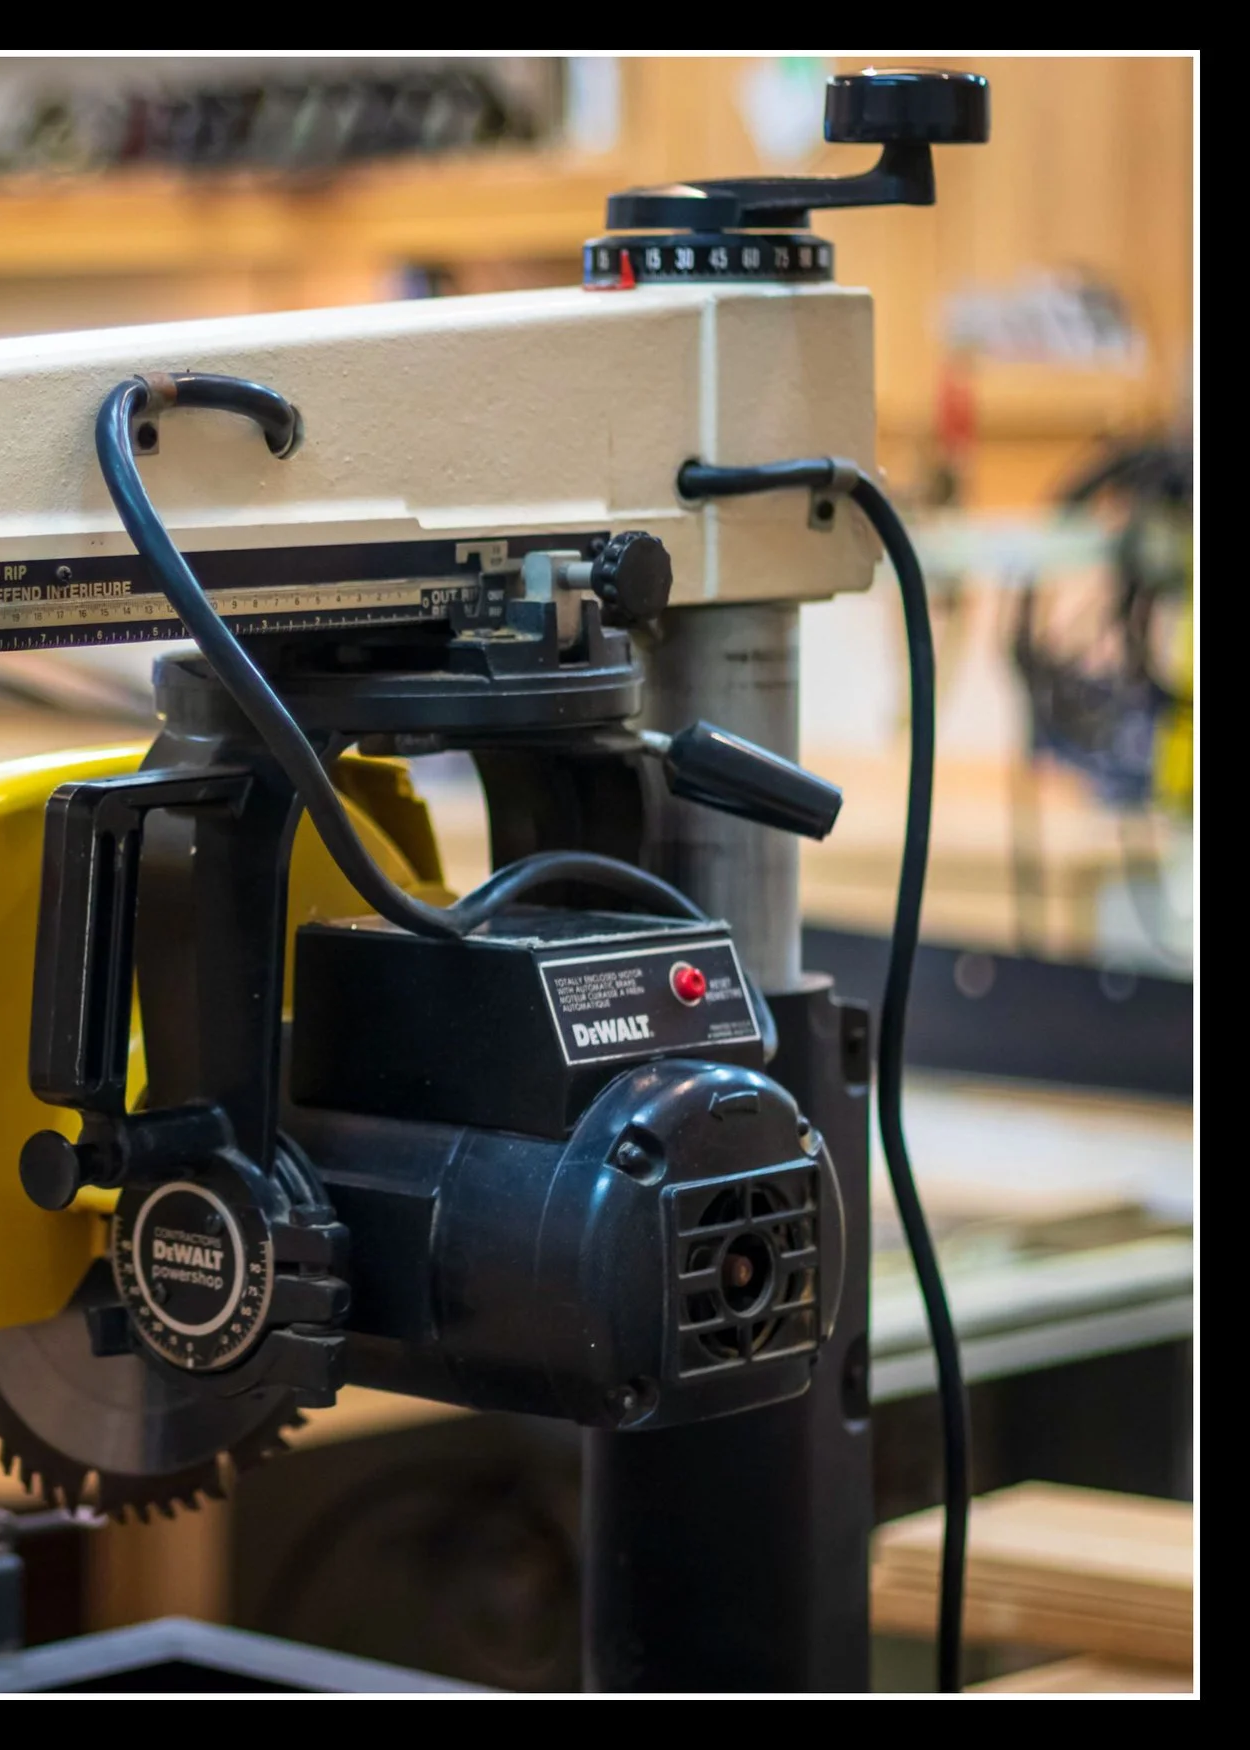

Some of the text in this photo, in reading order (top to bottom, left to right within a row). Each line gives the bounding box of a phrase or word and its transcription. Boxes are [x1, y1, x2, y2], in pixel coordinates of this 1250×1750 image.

[645, 247, 662, 270] 15
[674, 247, 695, 270] 30
[709, 246, 728, 270] 45
[741, 246, 760, 269] 60
[4, 565, 27, 581] RIP
[46, 581, 132, 600] INTERIEURE
[431, 589, 458, 604] OUT
[12, 614, 20, 623] 19
[56, 610, 64, 619] 17
[78, 609, 87, 618] 16
[100, 608, 109, 617] 15
[123, 607, 131, 616] 14
[145, 605, 154, 614] 13
[231, 600, 238, 609] 9
[40, 634, 46, 643] 7
[97, 630, 103, 640] 6
[152, 627, 158, 636] 5
[262, 619, 268, 629] 3
[554, 977, 582, 988] TOTALLY
[576, 981, 613, 993] AUTOMATIC
[154, 1226, 222, 1248] CONTRACTORS
[151, 1264, 224, 1291] powershop
